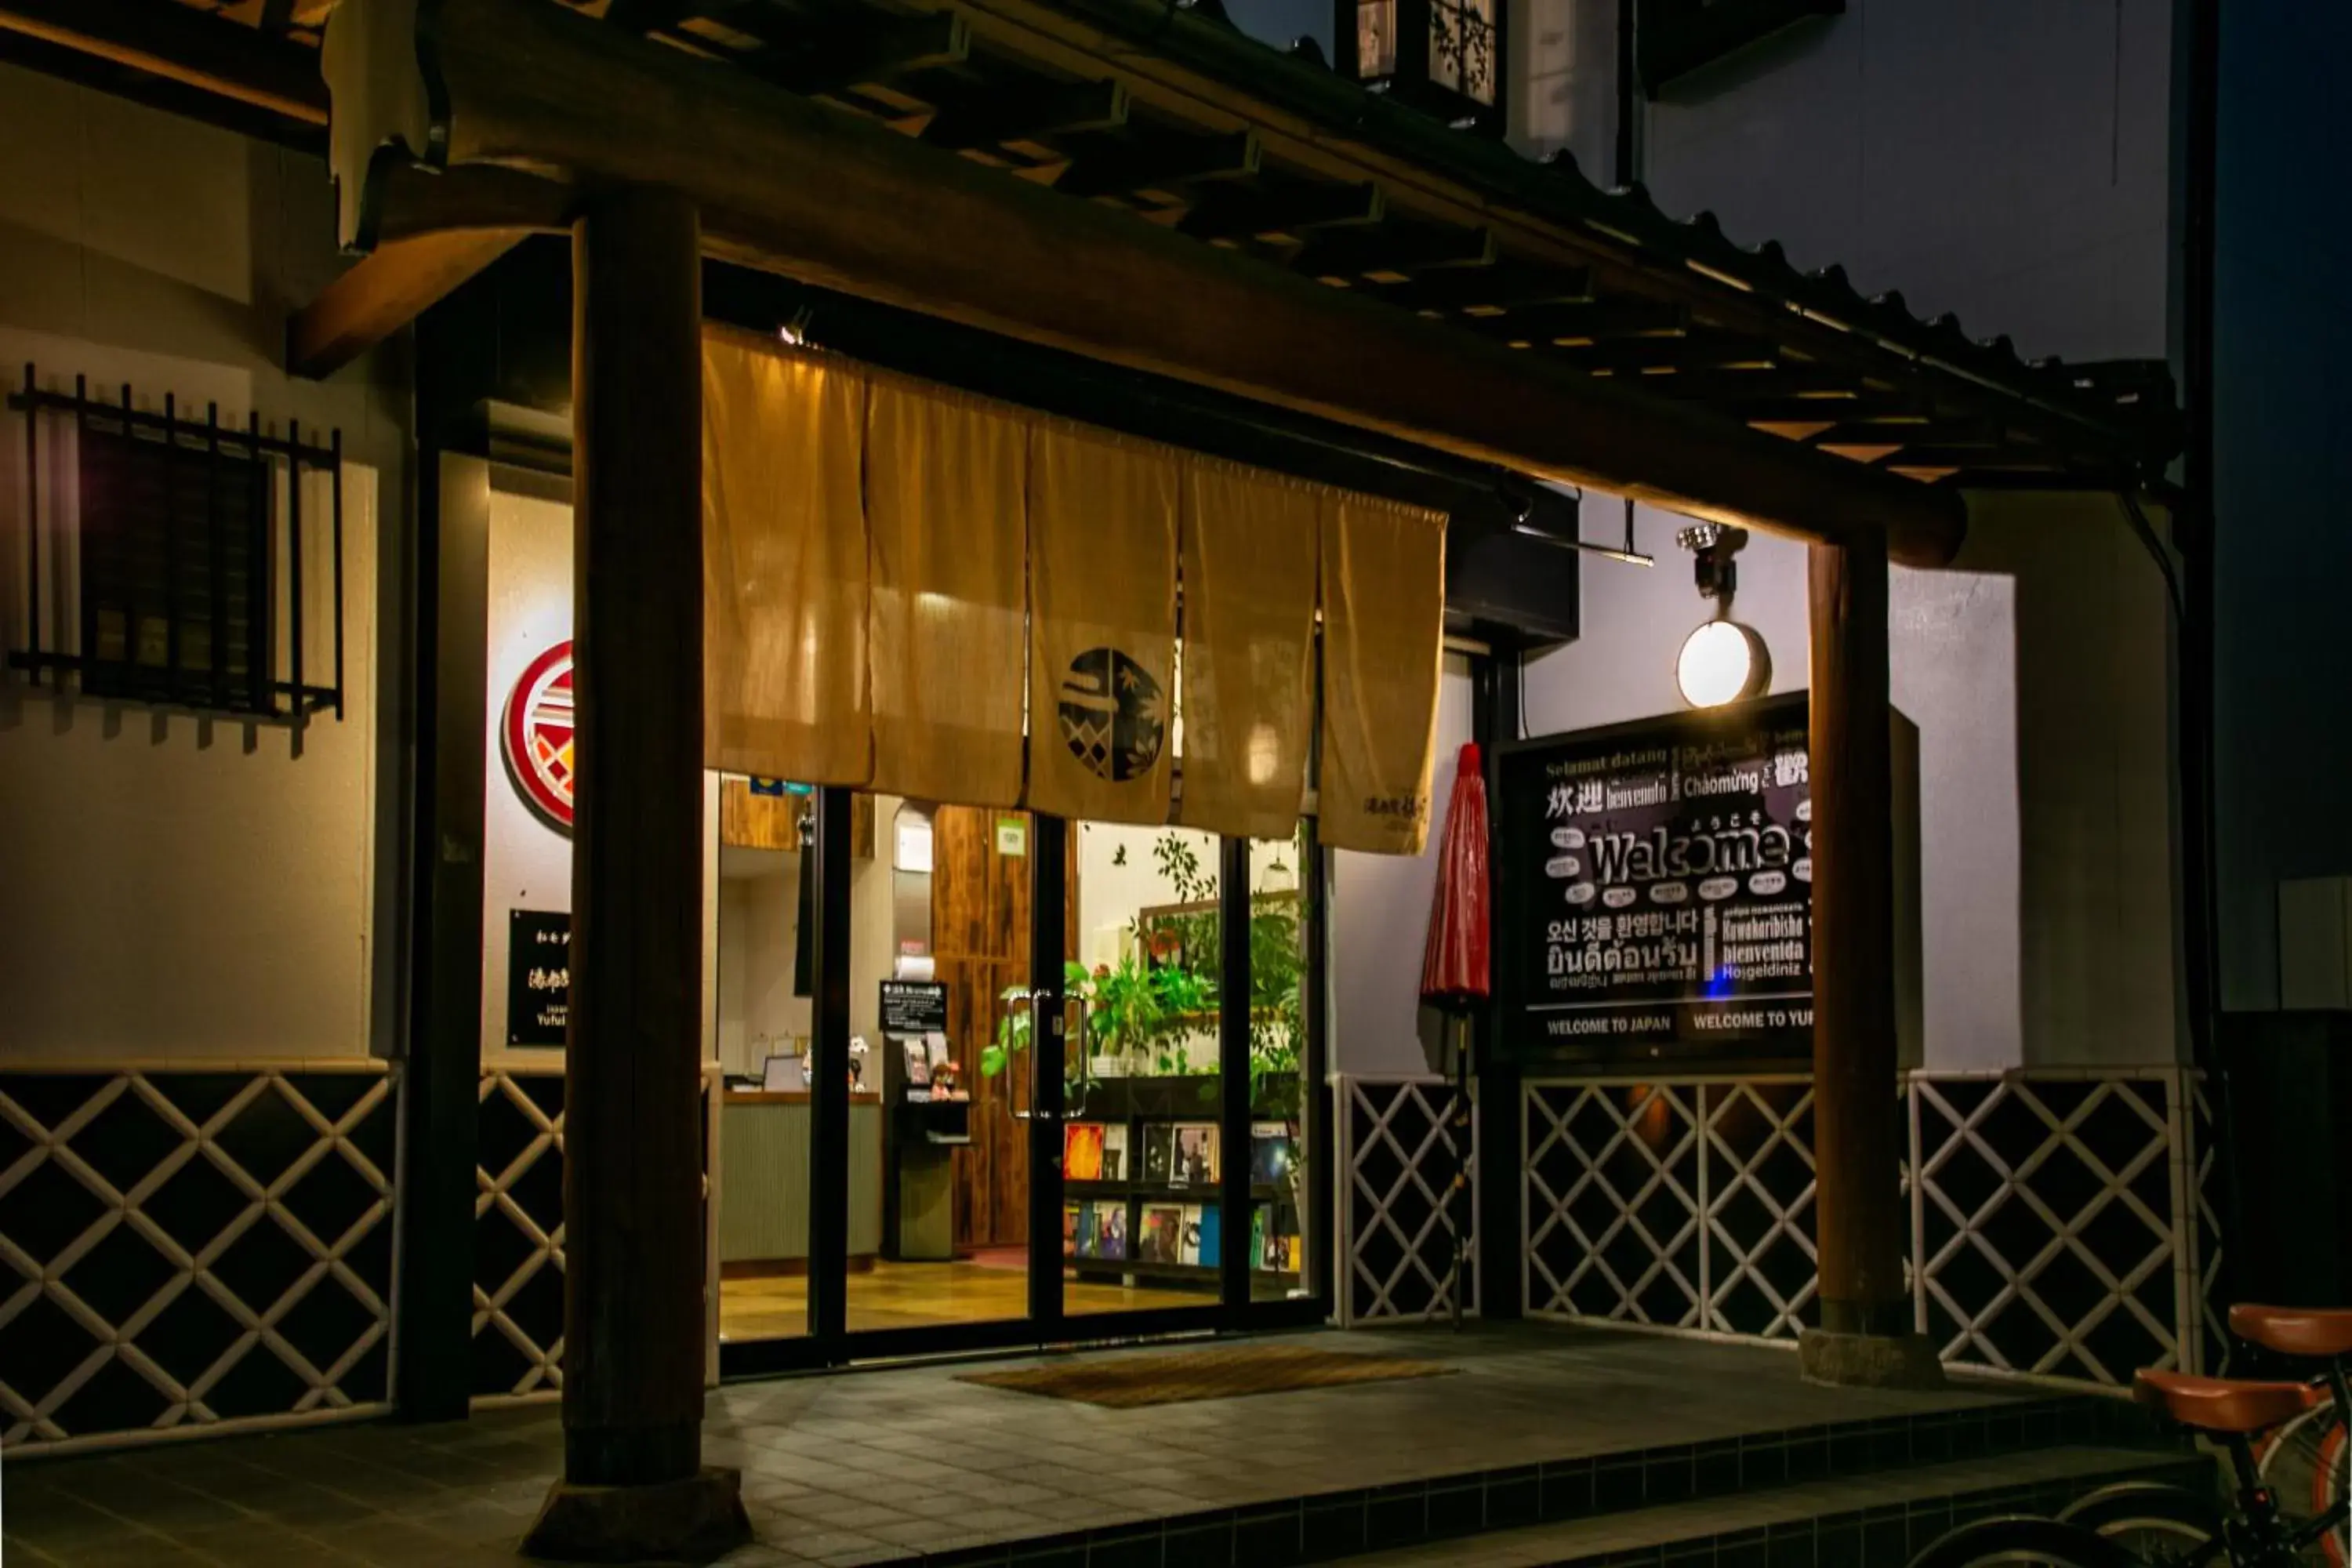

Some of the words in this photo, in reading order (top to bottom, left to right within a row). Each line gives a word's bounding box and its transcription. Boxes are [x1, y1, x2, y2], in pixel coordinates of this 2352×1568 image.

[1544, 779, 1603, 820] 欢迎
[1588, 825, 1791, 884] Welcome
[1547, 917, 1577, 943] 오신
[1581, 916, 1612, 942] 것을
[1617, 907, 1700, 939] 환영합니다
[1548, 1018, 1609, 1036] WELCOME
[1612, 1017, 1628, 1033] TO
[1631, 1015, 1671, 1032] JAPAN
[1693, 1011, 1764, 1030] WELCOME
[1767, 1009, 1786, 1027] TO
